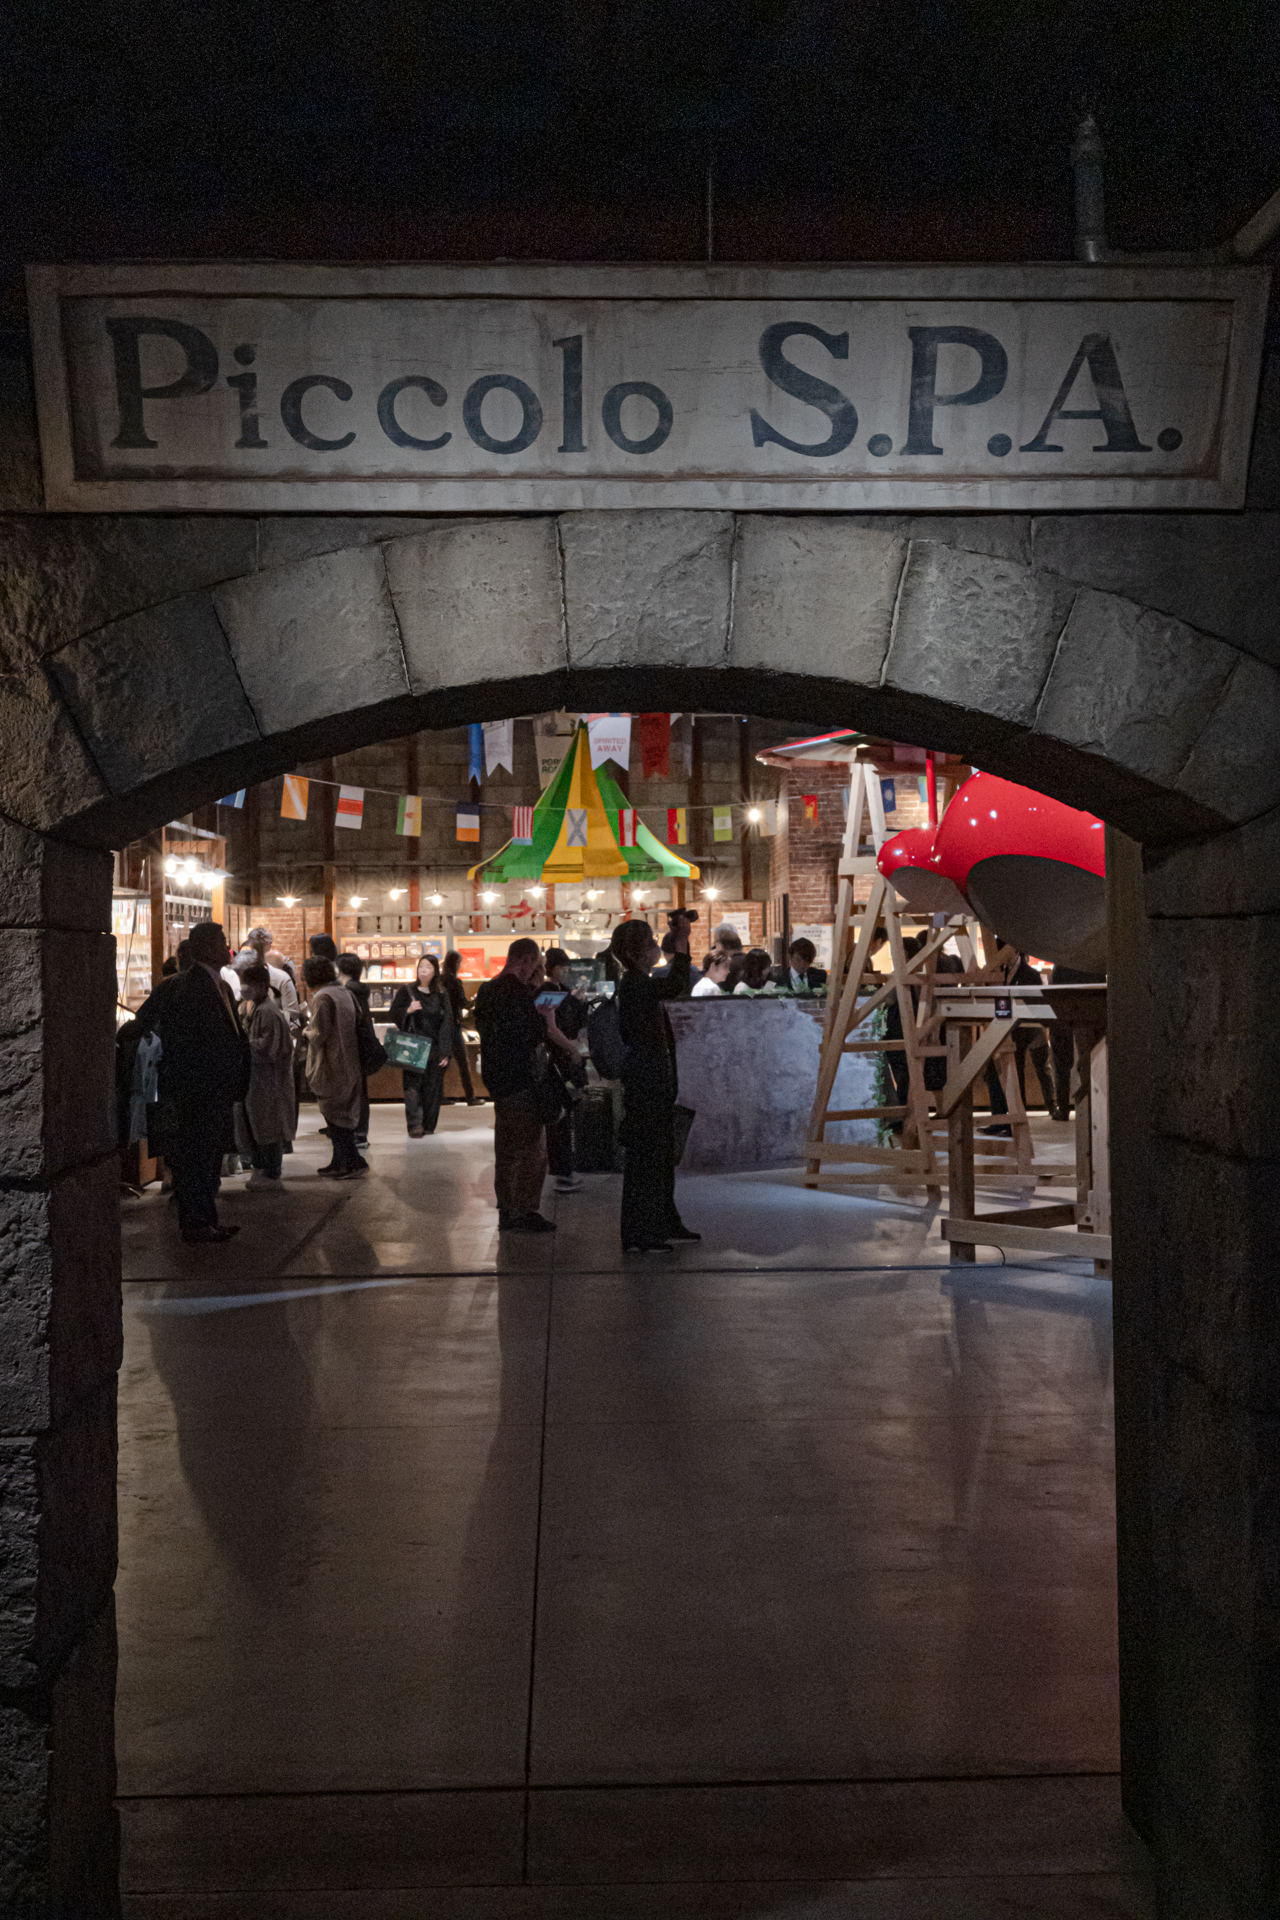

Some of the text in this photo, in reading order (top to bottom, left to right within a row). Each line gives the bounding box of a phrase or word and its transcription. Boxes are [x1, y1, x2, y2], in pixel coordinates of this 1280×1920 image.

[105, 316, 1183, 457] Piccolo S.P.A.
[593, 737, 627, 745] SPIRITED
[597, 744, 623, 752] AWAY
